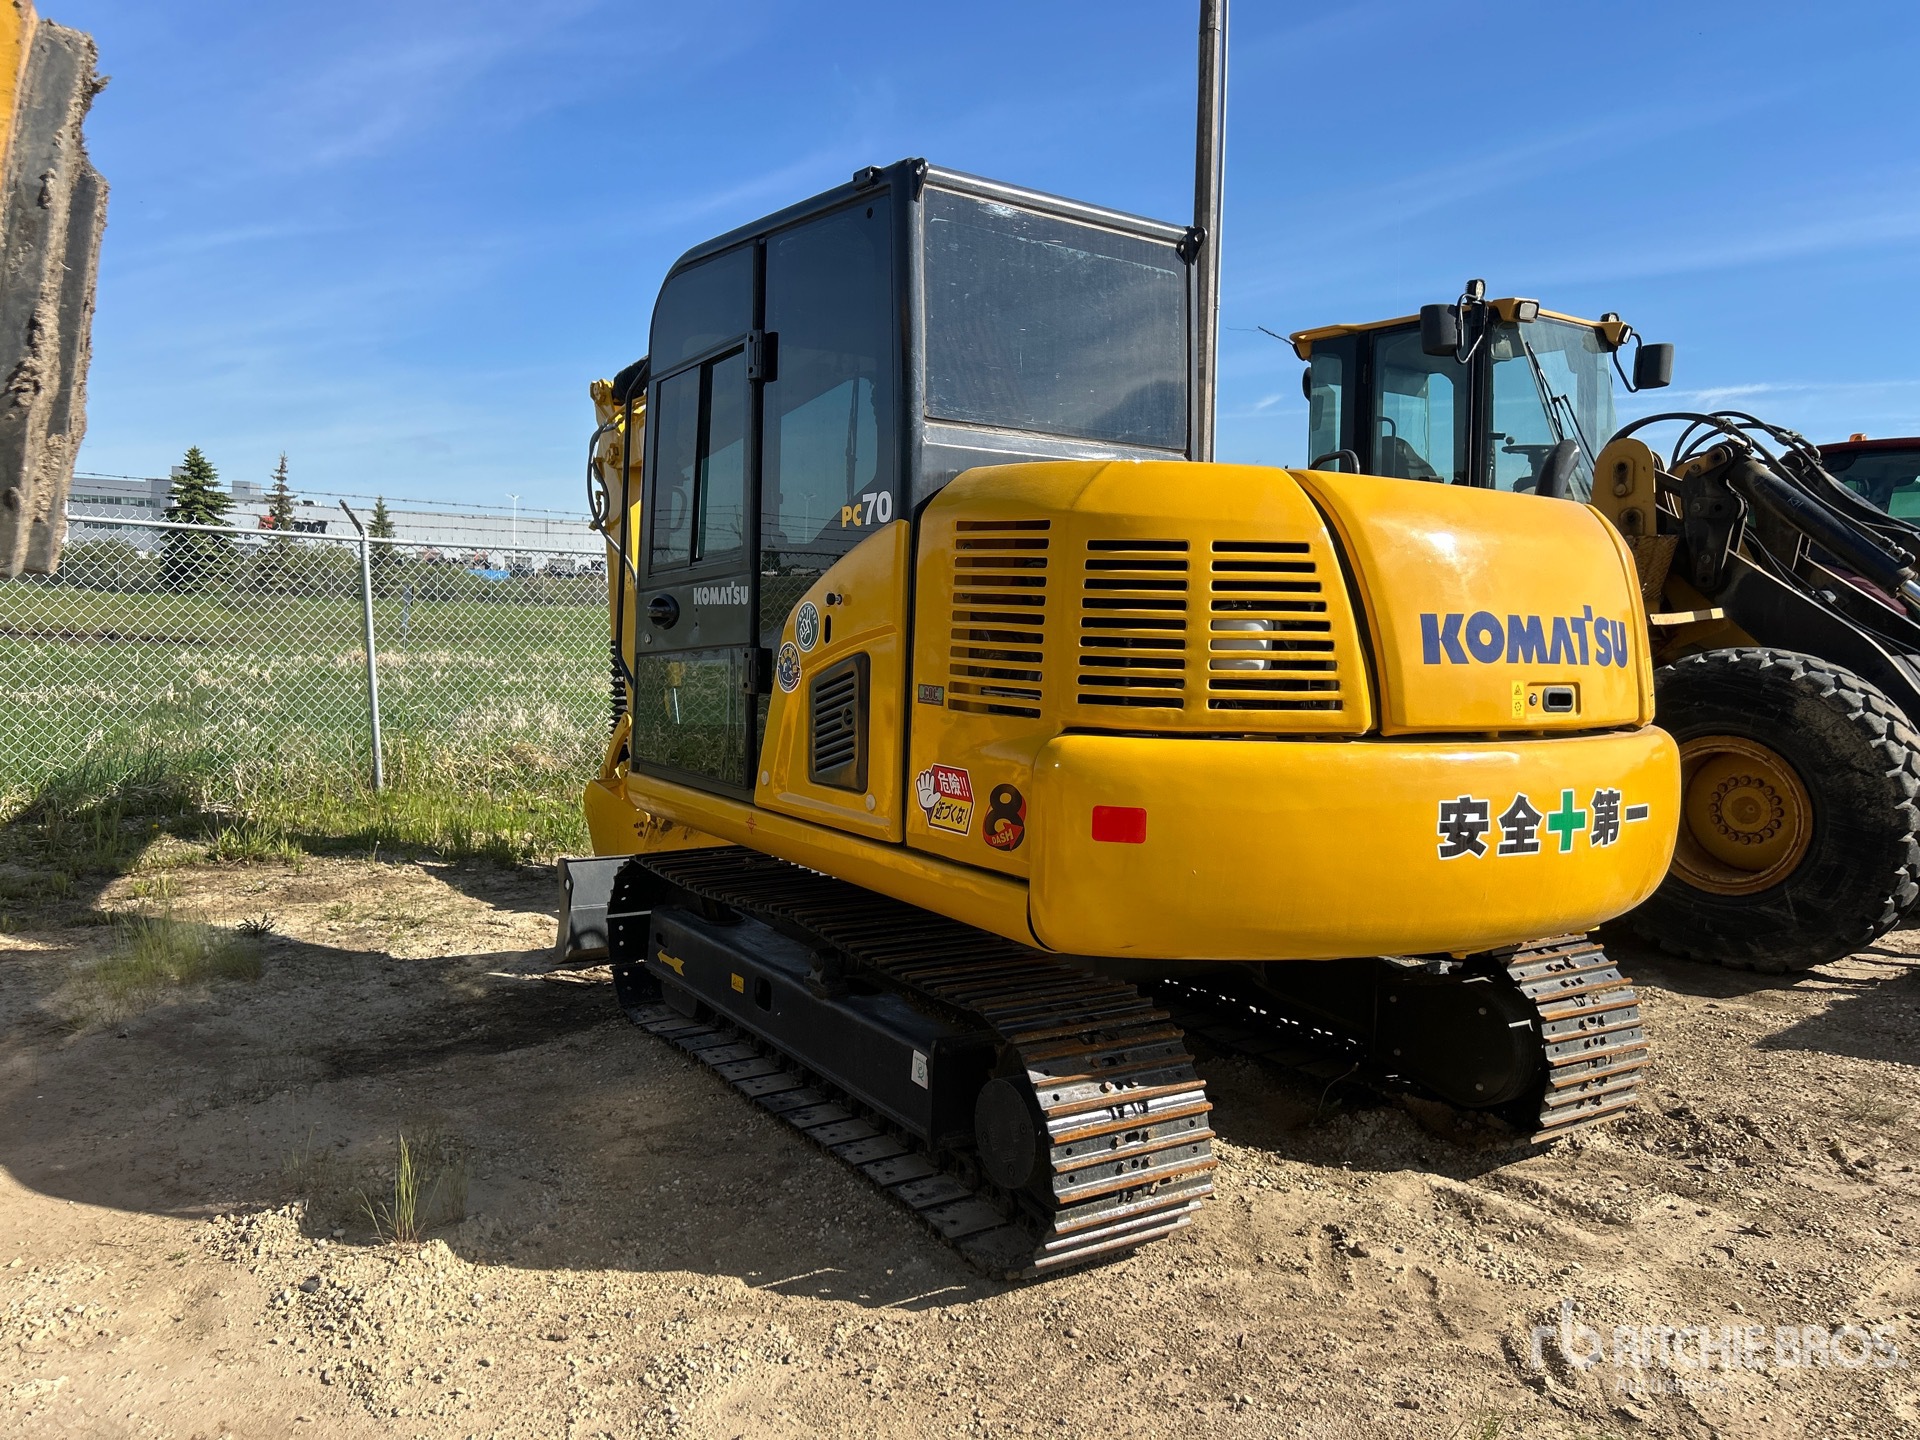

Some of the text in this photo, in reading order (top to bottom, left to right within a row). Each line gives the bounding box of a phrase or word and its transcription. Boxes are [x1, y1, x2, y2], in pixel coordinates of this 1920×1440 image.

[842, 491, 892, 528] PC70
[693, 581, 749, 606] KOMATSU
[1420, 604, 1628, 668] KOMATSU
[985, 783, 1024, 851] 8
[992, 828, 1014, 844] DASH
